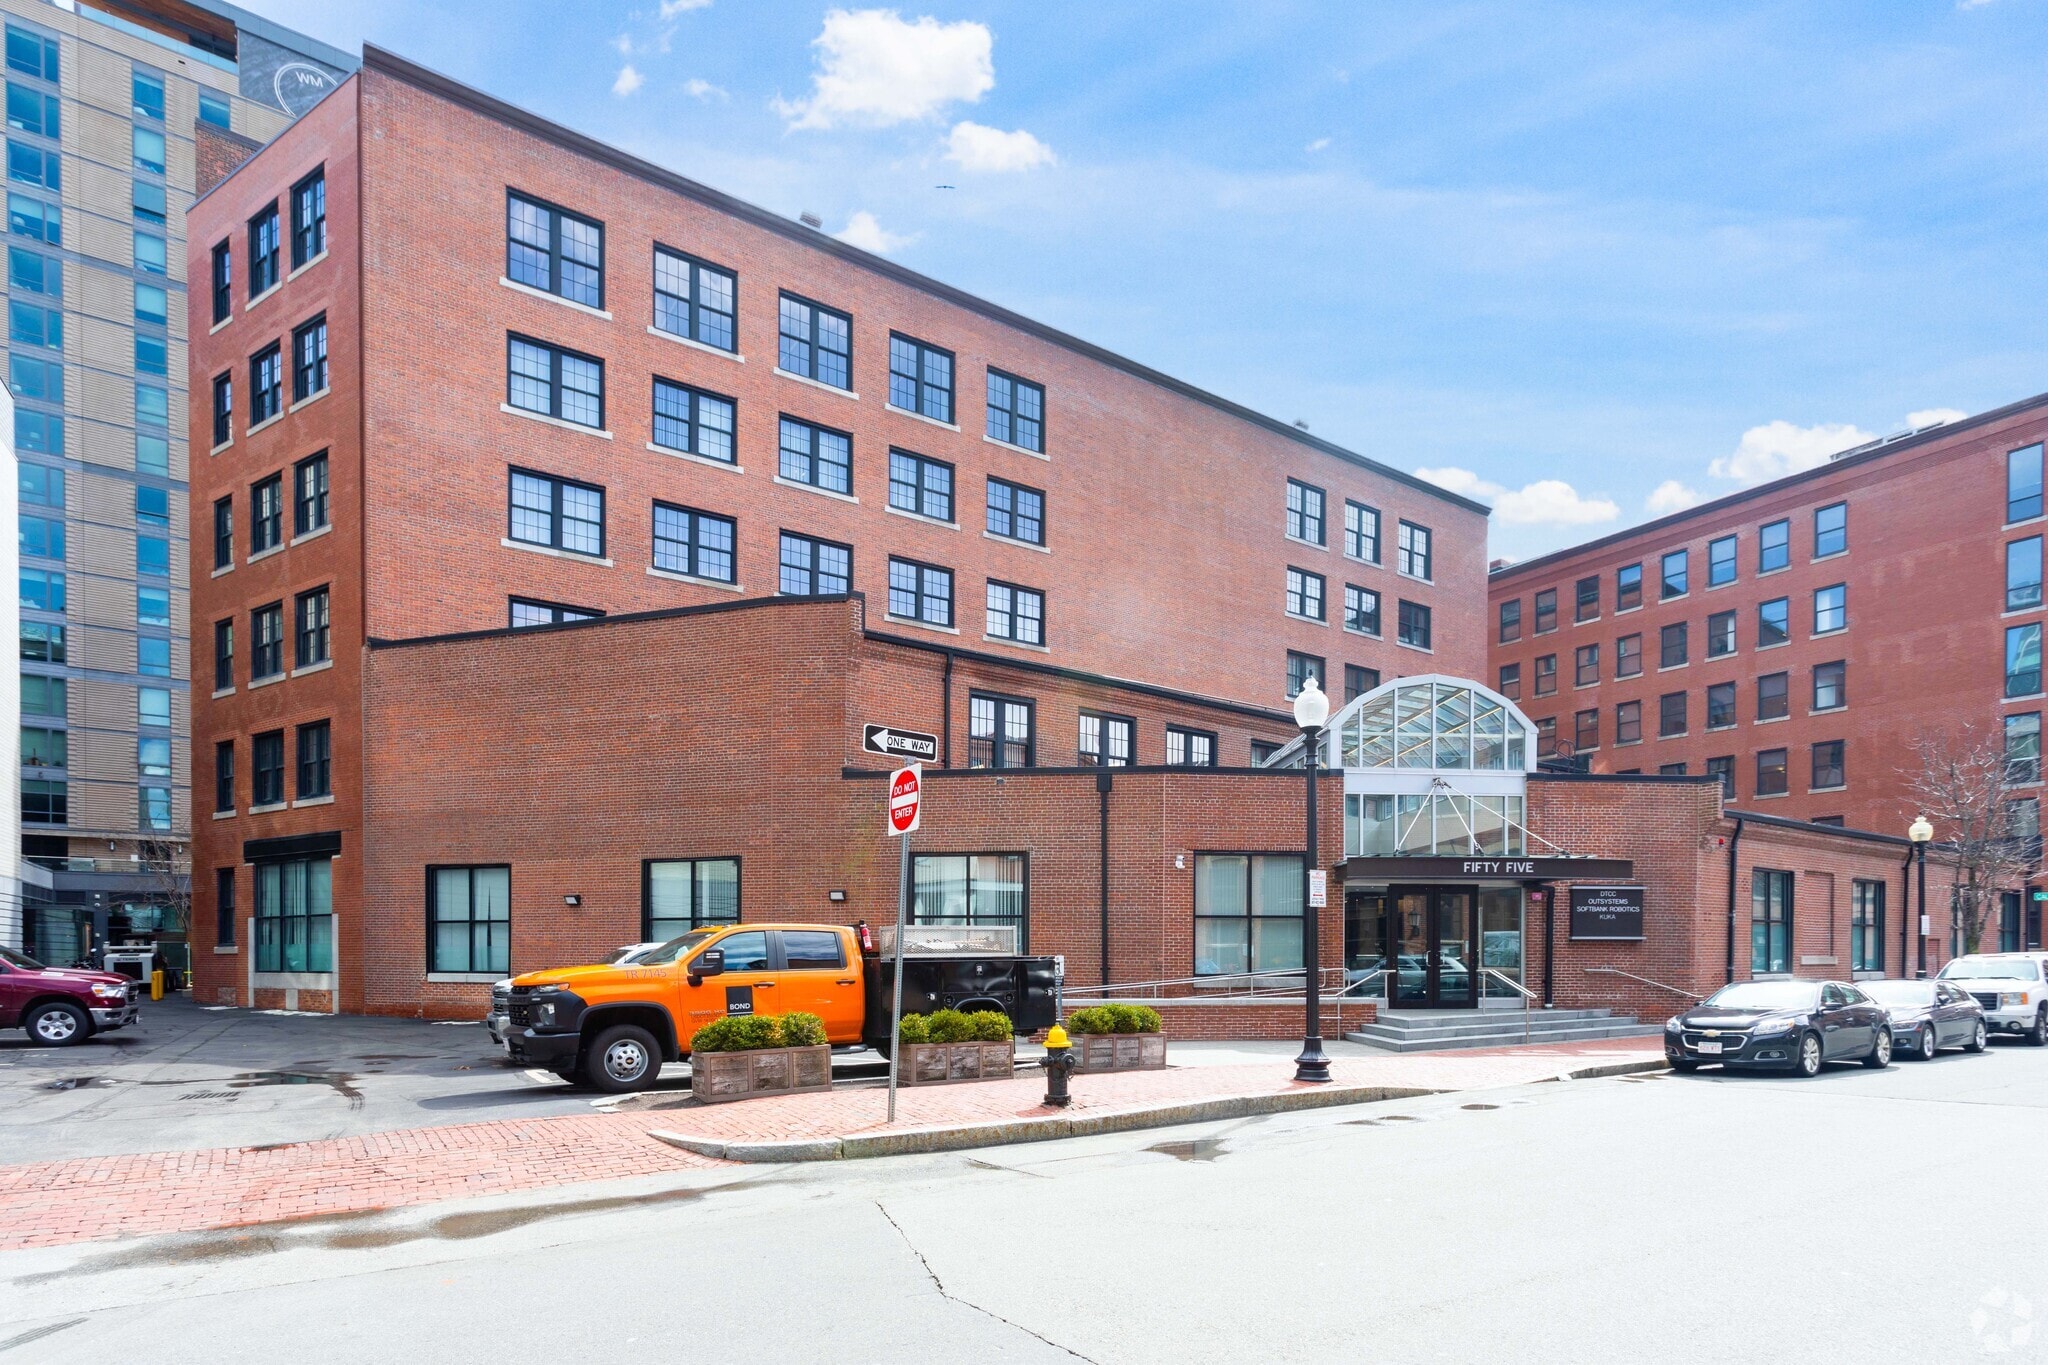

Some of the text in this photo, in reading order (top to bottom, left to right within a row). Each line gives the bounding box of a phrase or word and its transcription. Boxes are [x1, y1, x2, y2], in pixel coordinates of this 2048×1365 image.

[295, 71, 324, 88] WM
[886, 736, 931, 753] ONE WAY
[894, 781, 916, 796] DO NOT
[894, 806, 914, 820] ENTER
[1463, 861, 1535, 873] FIFTY FIVE
[1576, 905, 1609, 913] SOFTBANK
[624, 968, 667, 979] TR 7145
[729, 1002, 751, 1010] BOND
